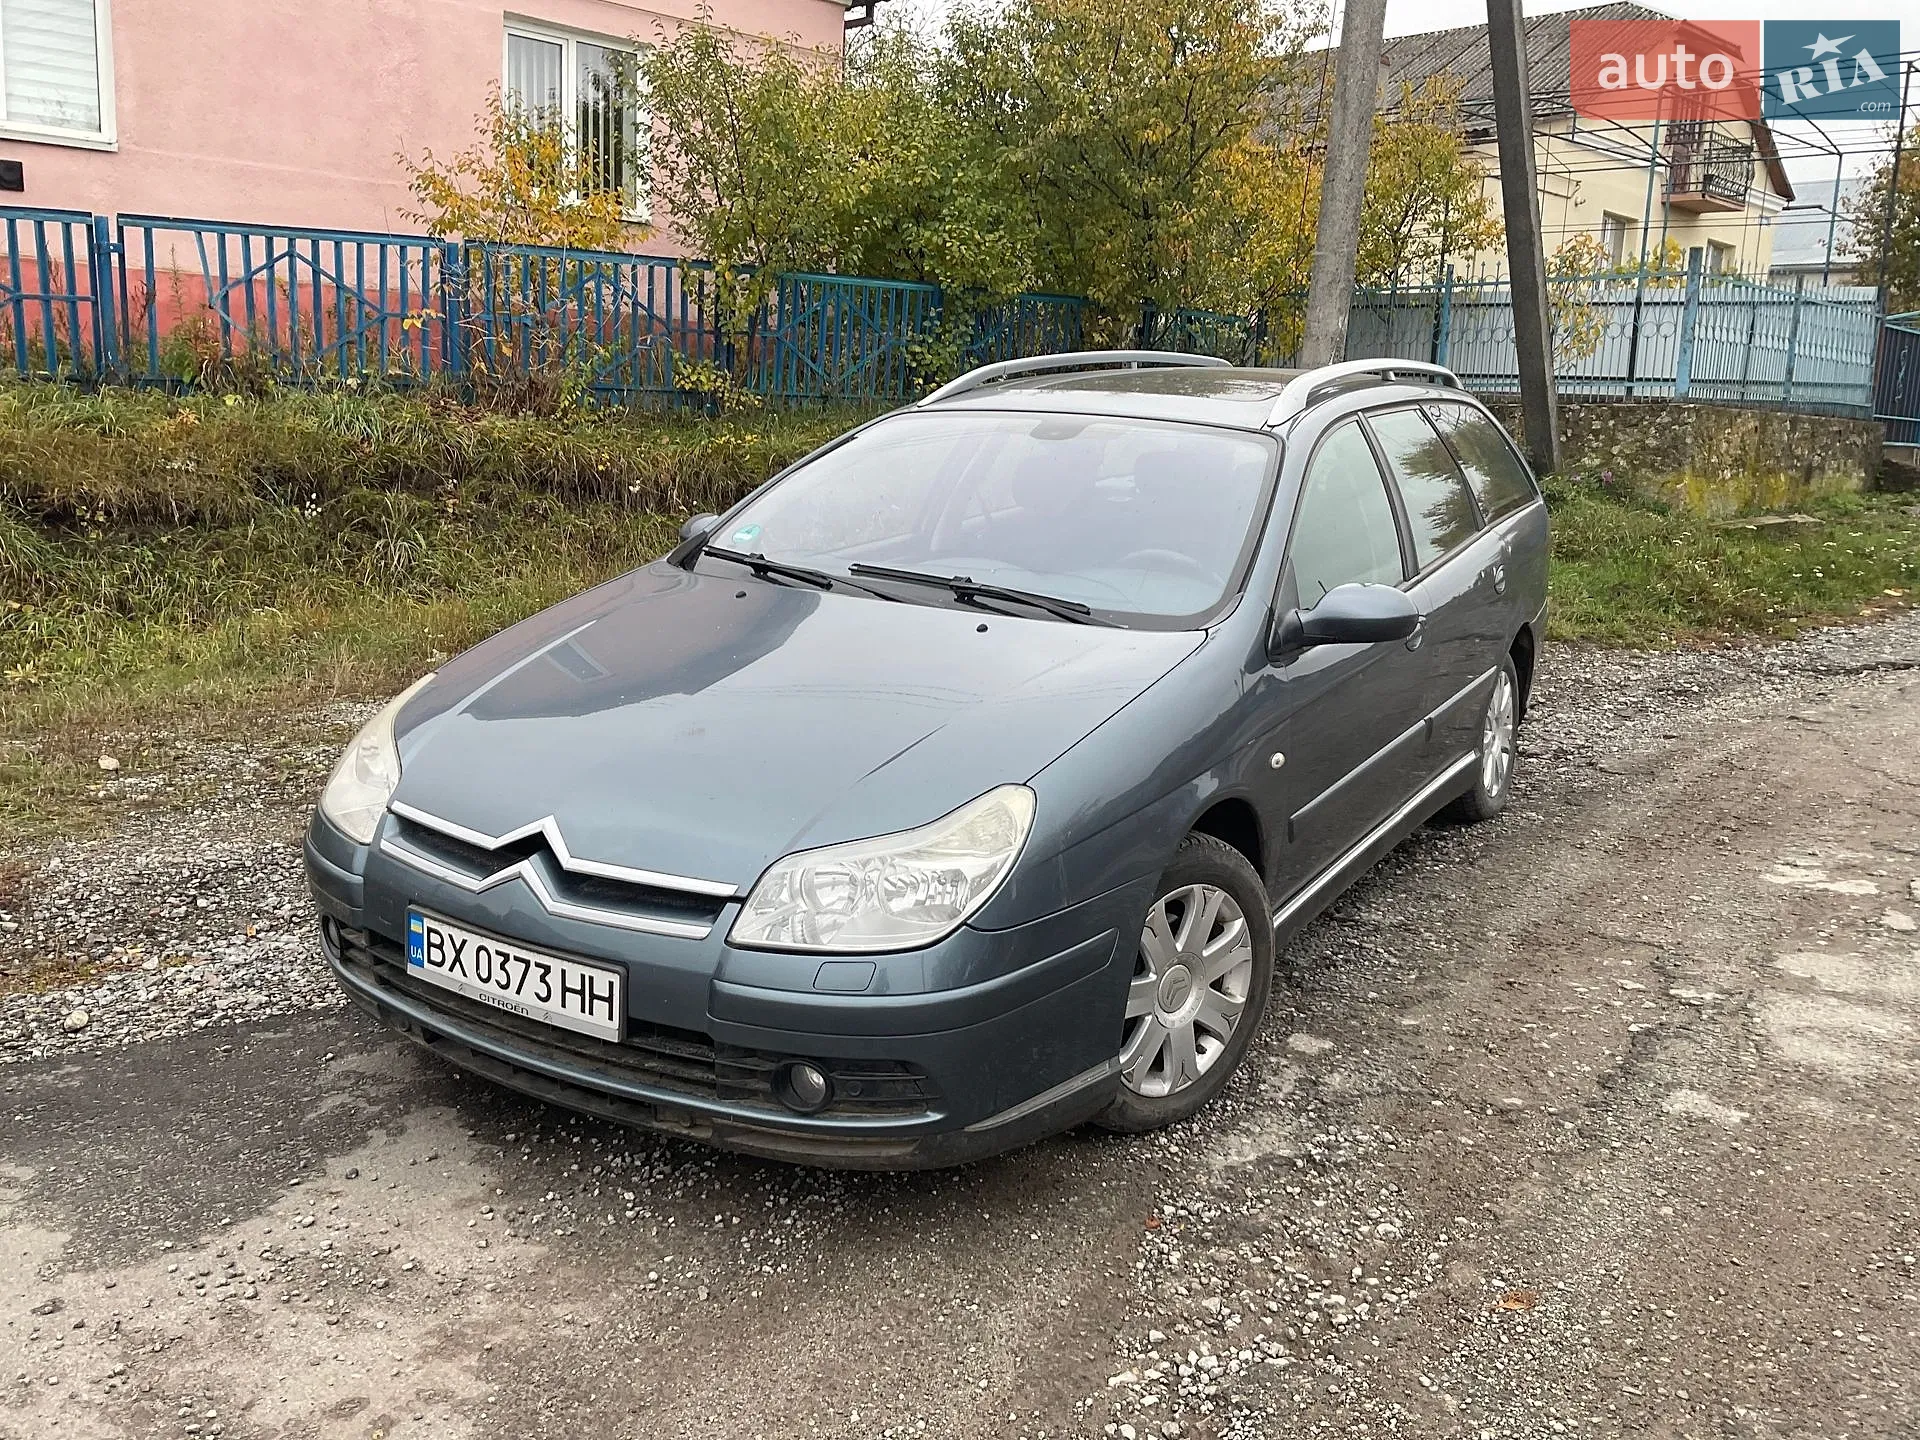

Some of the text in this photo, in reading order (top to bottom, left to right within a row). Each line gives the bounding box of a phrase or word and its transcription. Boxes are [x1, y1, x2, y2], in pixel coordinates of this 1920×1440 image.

[411, 946, 423, 961] UA
[426, 926, 614, 1022] BX 0373 HH
